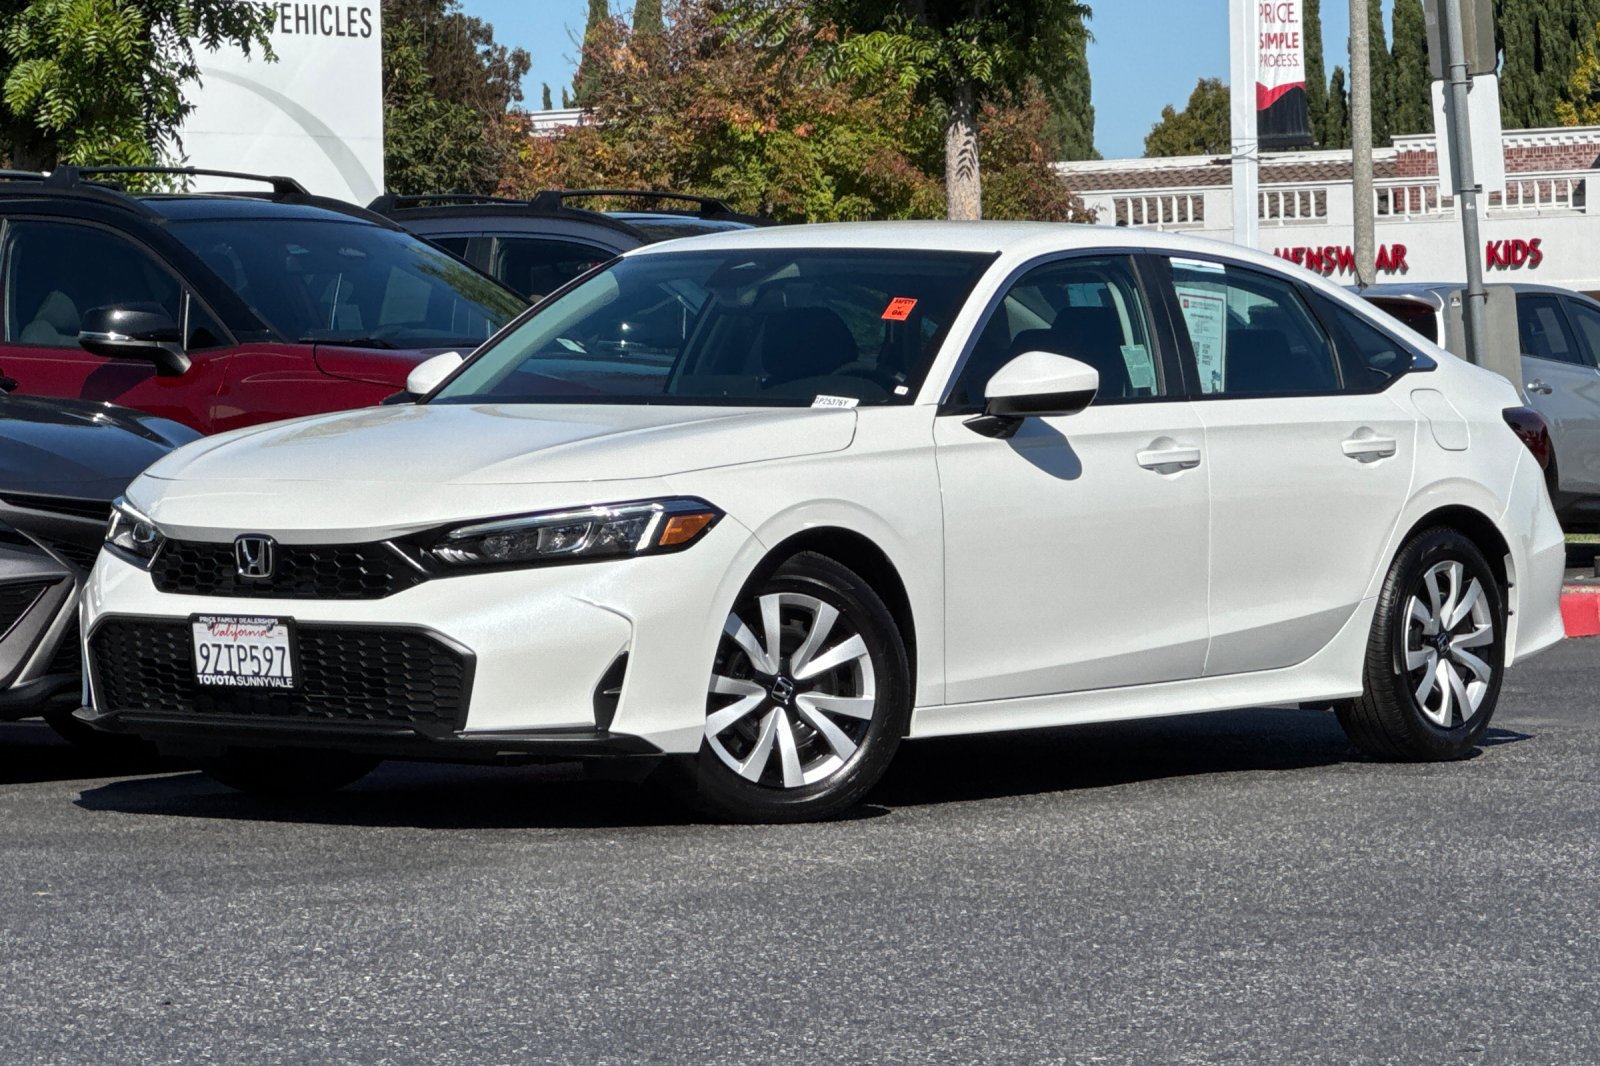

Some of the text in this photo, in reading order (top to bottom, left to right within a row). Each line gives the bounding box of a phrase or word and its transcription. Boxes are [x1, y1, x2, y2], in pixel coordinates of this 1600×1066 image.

[1273, 244, 1409, 273] ENSWAR
[1485, 238, 1543, 270] KIDS
[211, 623, 270, 641] California
[197, 674, 294, 688] TOYOTA SUNNYVALE
